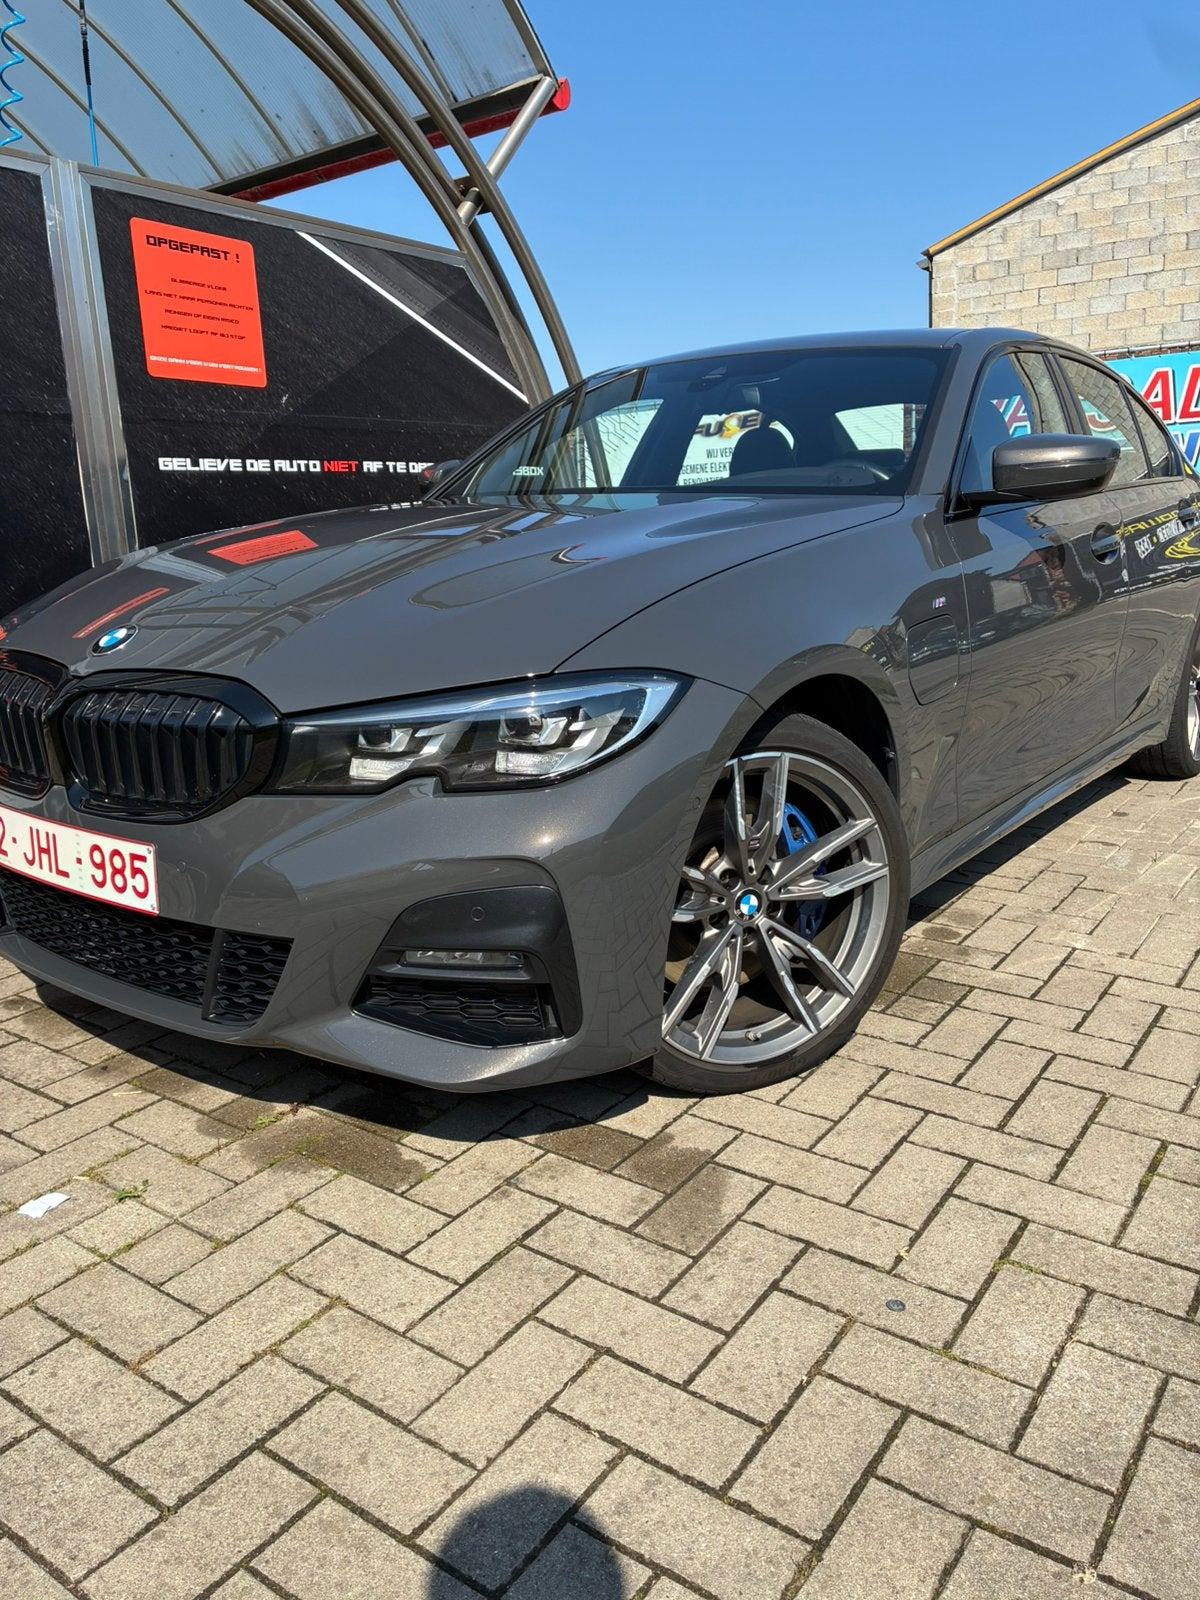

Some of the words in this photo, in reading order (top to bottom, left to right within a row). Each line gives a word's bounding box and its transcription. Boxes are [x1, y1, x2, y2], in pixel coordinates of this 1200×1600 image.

[145, 234, 230, 261] OPGEPAST
[235, 253, 240, 264] !
[158, 457, 242, 472] GELIEVE
[245, 458, 271, 473] DE
[274, 459, 321, 472] AUTO
[323, 460, 358, 472] NIET
[363, 460, 383, 473] AF
[385, 461, 407, 473] TE
